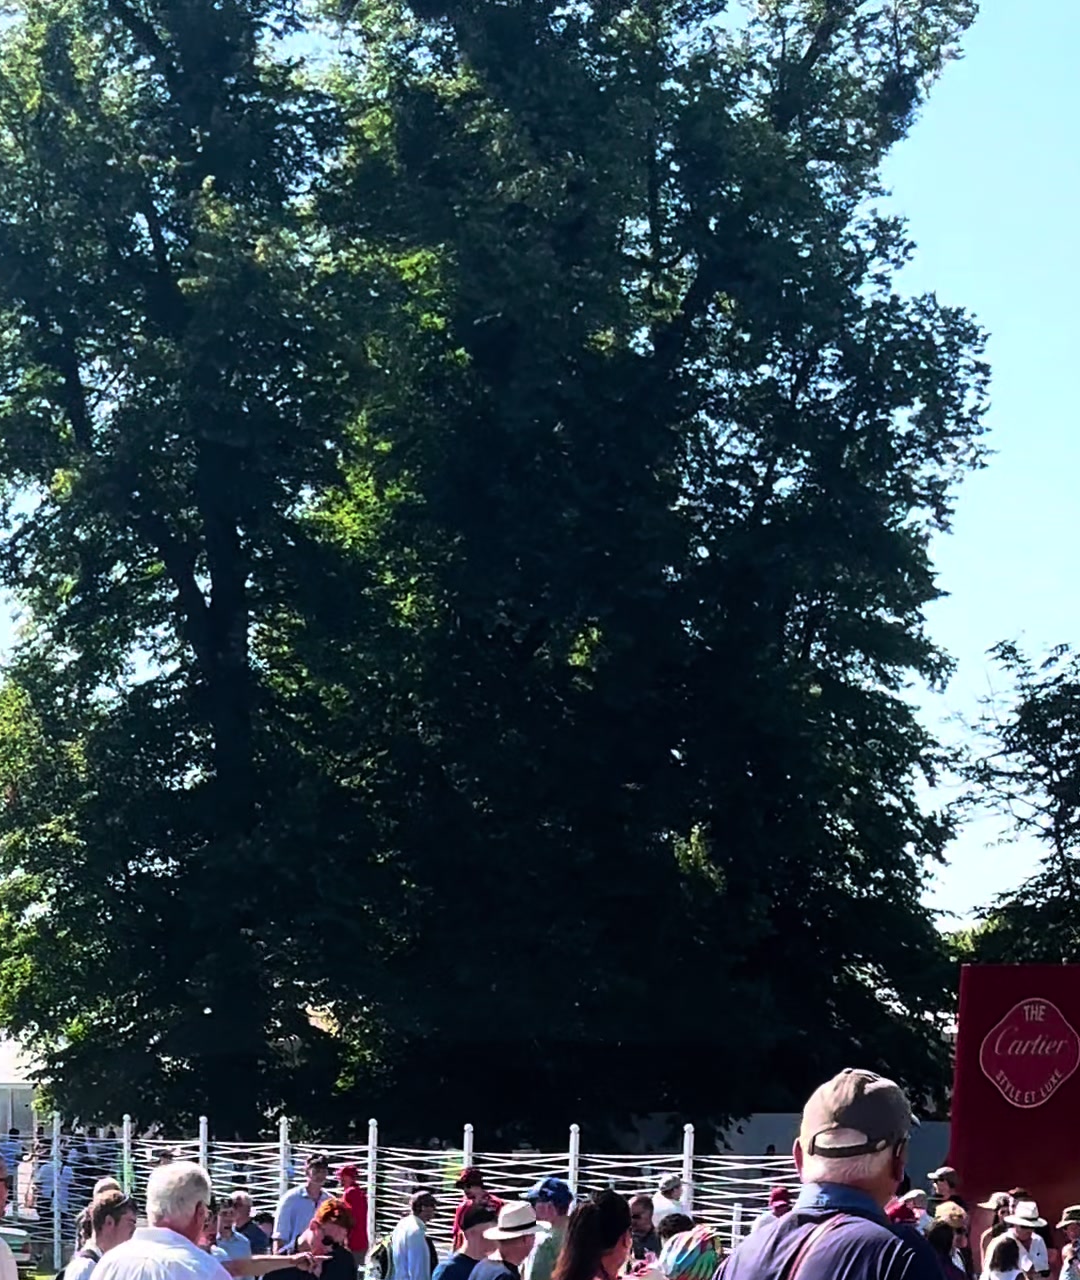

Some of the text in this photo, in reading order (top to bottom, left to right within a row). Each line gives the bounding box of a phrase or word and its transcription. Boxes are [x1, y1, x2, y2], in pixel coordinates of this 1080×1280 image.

[1023, 1004, 1047, 1022] THE
[994, 1026, 1068, 1055] Cartier
[995, 1068, 1062, 1104] STYLE ET LUXE
